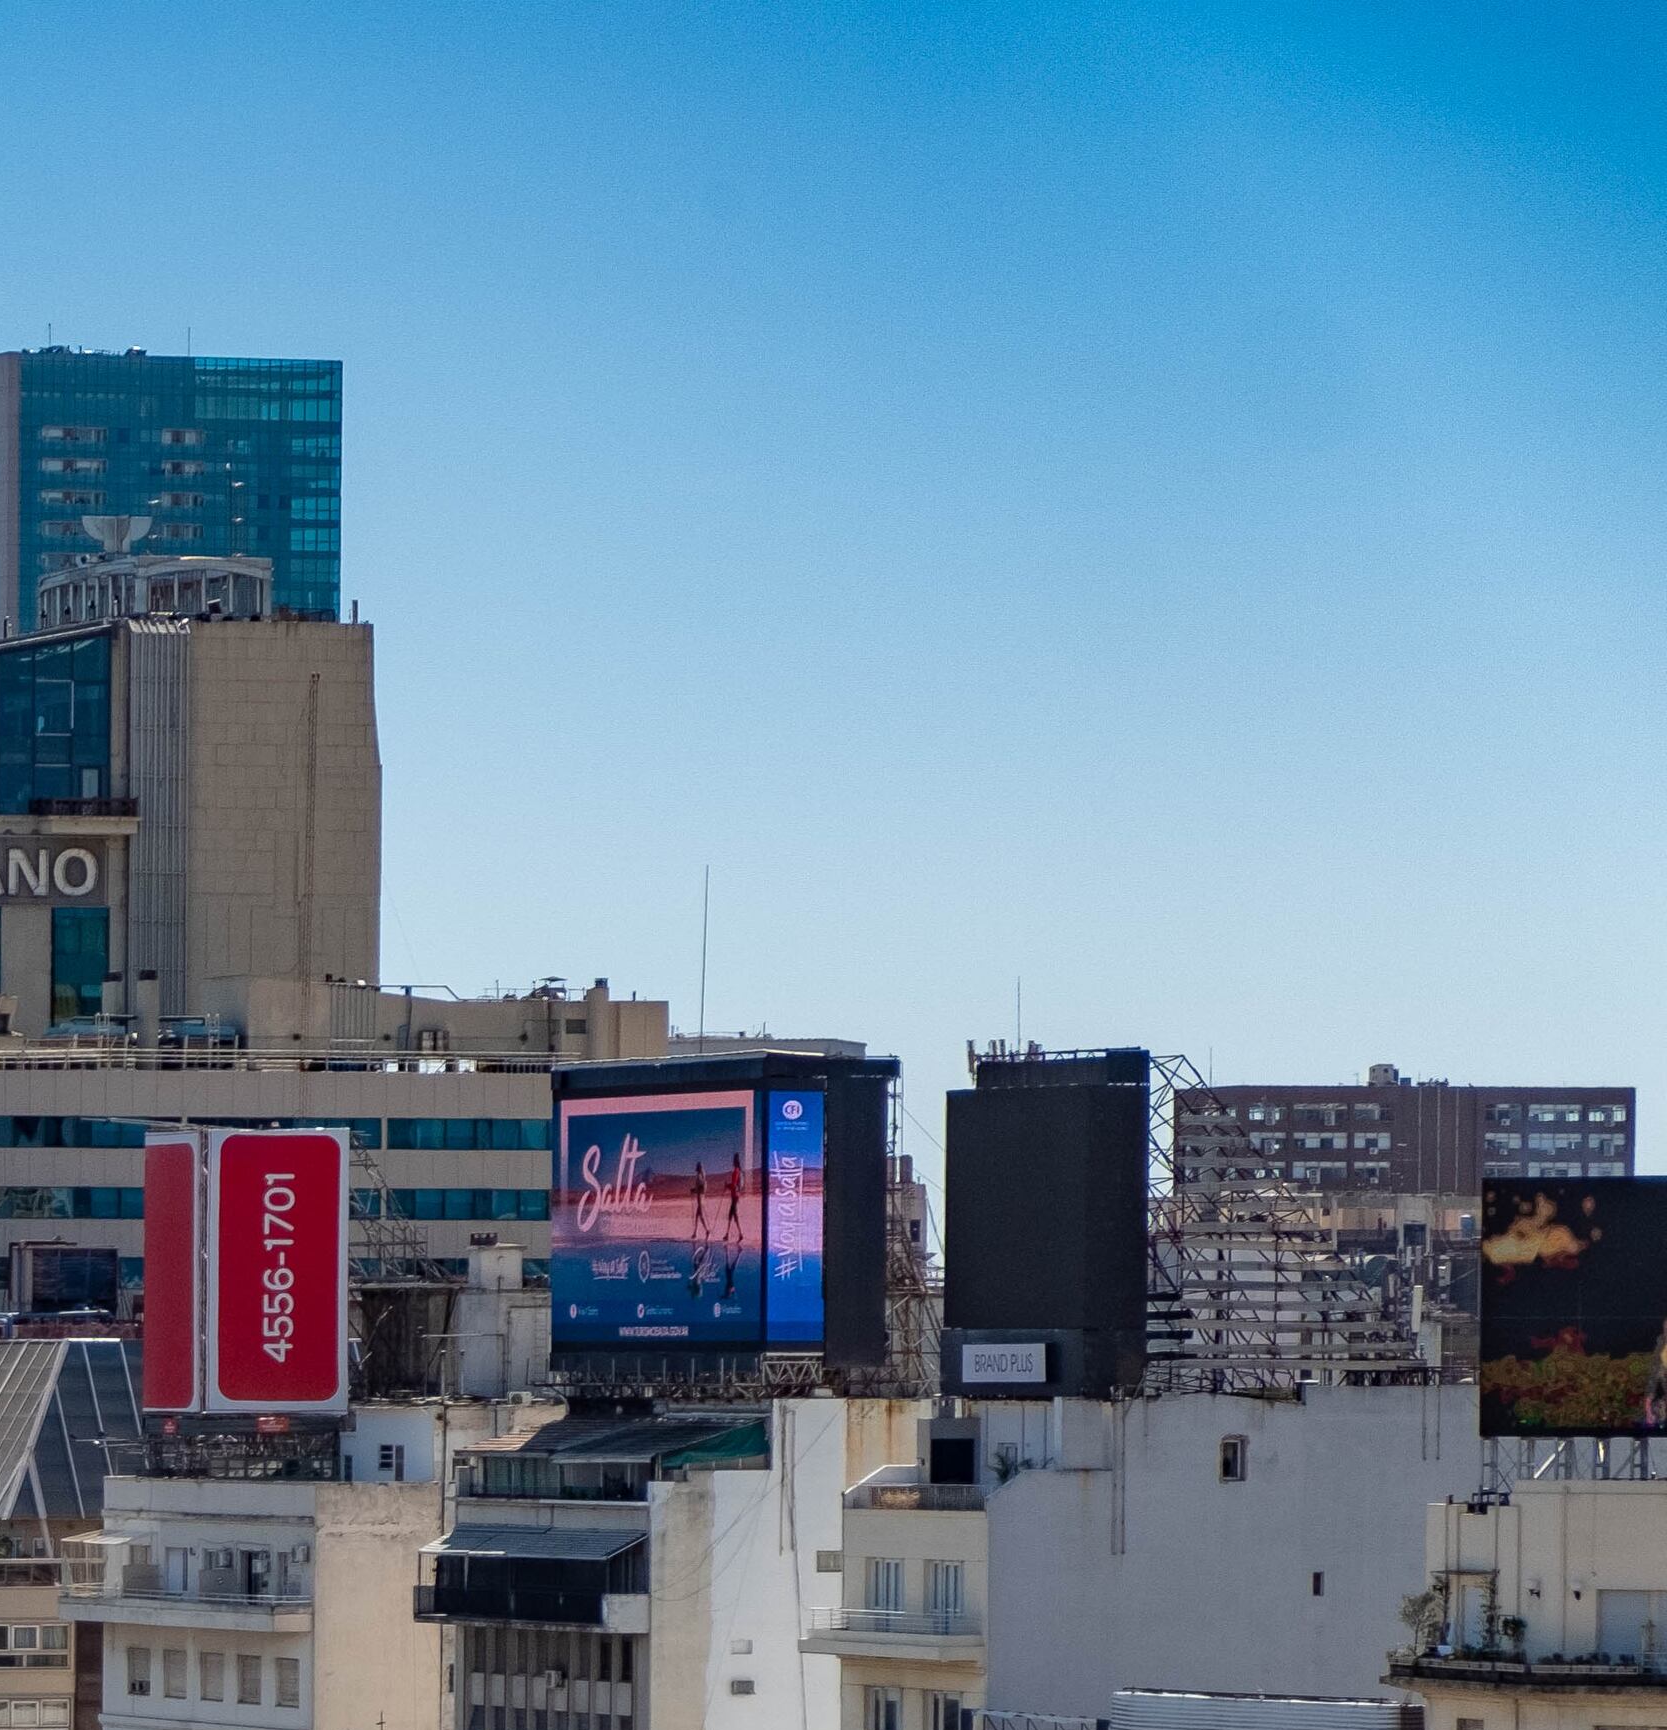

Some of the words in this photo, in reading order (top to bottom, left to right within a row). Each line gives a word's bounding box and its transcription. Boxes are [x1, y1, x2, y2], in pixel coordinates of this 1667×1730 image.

[577, 1132, 655, 1233] Salta
[262, 1172, 297, 1365] 4556-1701
[974, 1353, 1008, 1373] BRAND
